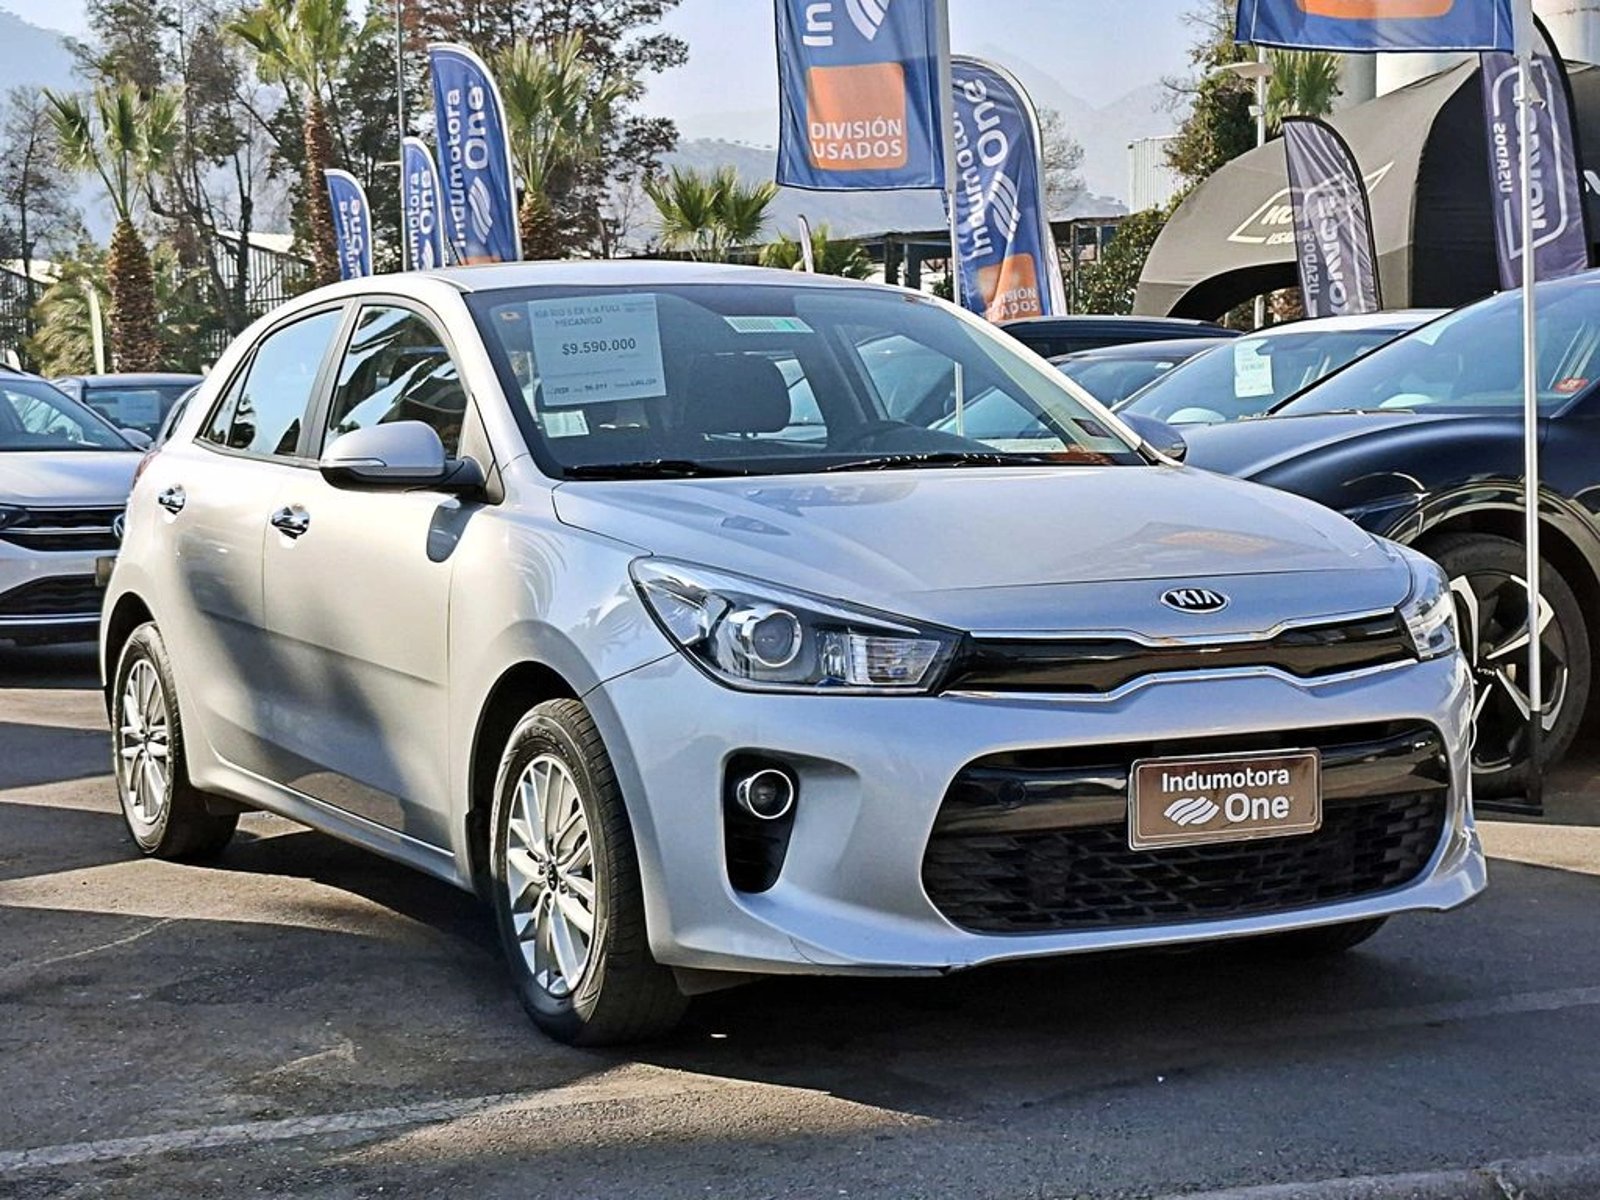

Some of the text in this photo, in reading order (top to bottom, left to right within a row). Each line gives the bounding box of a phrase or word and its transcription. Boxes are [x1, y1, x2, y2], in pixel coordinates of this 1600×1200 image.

[465, 86, 489, 170] One
[811, 117, 902, 140] DIVISIÓN
[964, 79, 1008, 167] One
[447, 89, 467, 248] Indumotora
[812, 140, 902, 160] USADOS
[420, 170, 434, 235] One
[953, 111, 993, 260] Indumoto
[407, 172, 420, 271] umotora
[561, 338, 637, 356] $9.590.000
[1171, 590, 1222, 606] KIA
[1161, 768, 1290, 793] Indumotora
[1224, 793, 1290, 823] One
